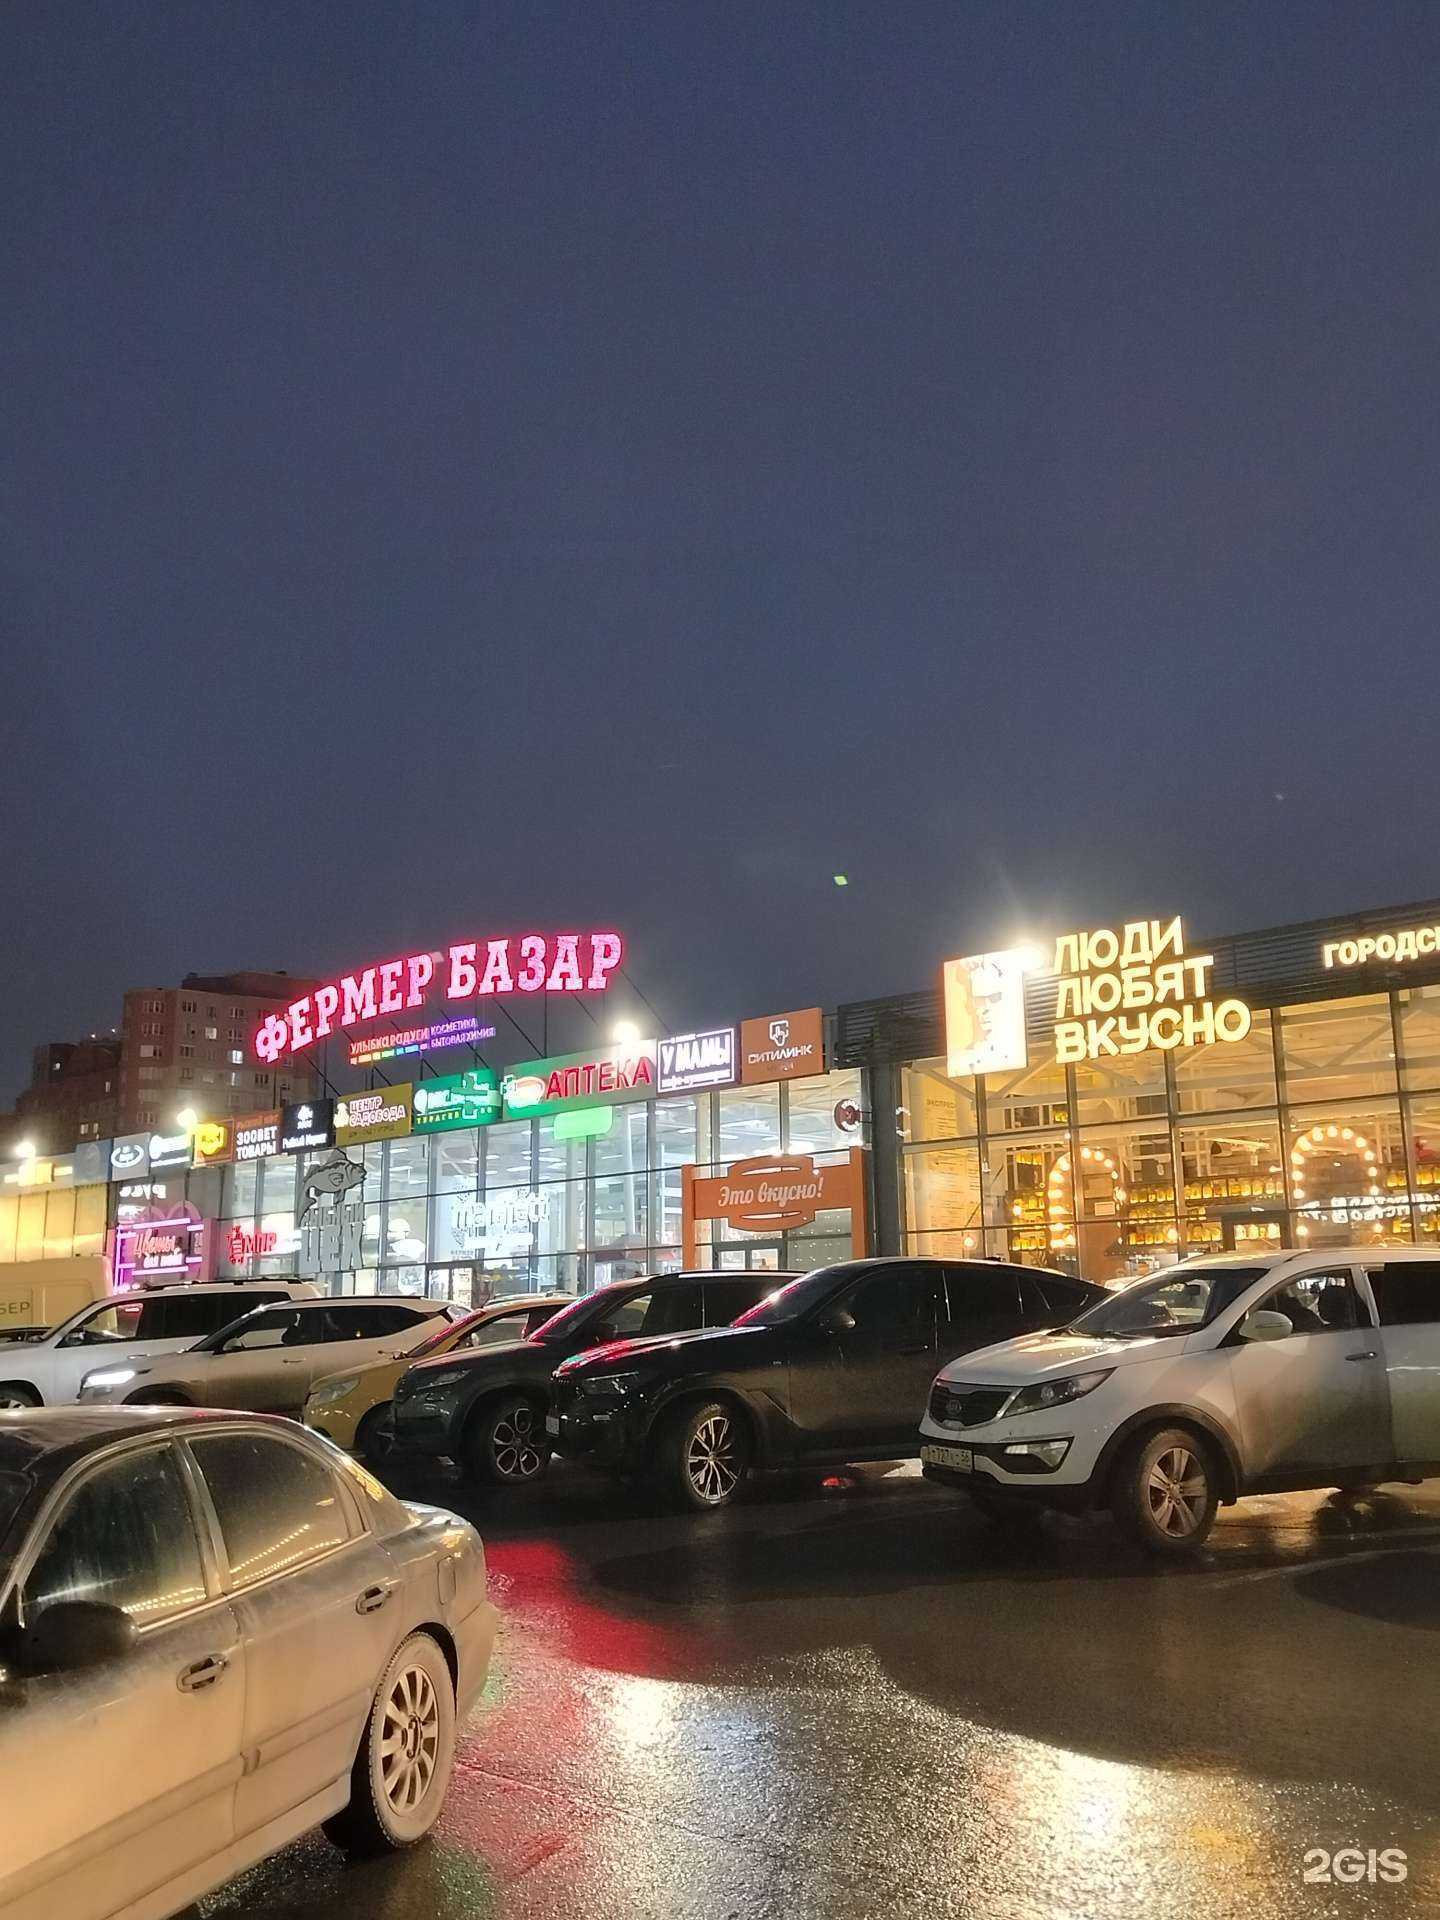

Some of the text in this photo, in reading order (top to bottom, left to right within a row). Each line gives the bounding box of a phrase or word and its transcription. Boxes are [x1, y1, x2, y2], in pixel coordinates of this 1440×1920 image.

[1053, 915, 1185, 975] ЛЮДИ
[1323, 926, 1440, 969] ГОРОДС
[255, 934, 622, 1063] ФЕРМЕР БАЗАР
[1056, 953, 1215, 1019] ЛЮБЯТ
[430, 1017, 477, 1035] КОСМЕТИКА
[1054, 999, 1251, 1064] ВКУСНО
[661, 1034, 730, 1075] У МАМЫ
[748, 1044, 814, 1065] СИТИЛИНК
[547, 1056, 652, 1100] АПТЕКА
[350, 1095, 383, 1114] ЦЕНТР
[350, 1104, 406, 1127] САДОВОДА
[236, 1126, 278, 1146] ЗООВЕТ
[236, 1141, 277, 1160] ТОВАРЫ
[718, 1177, 824, 1208] Это вкусно!
